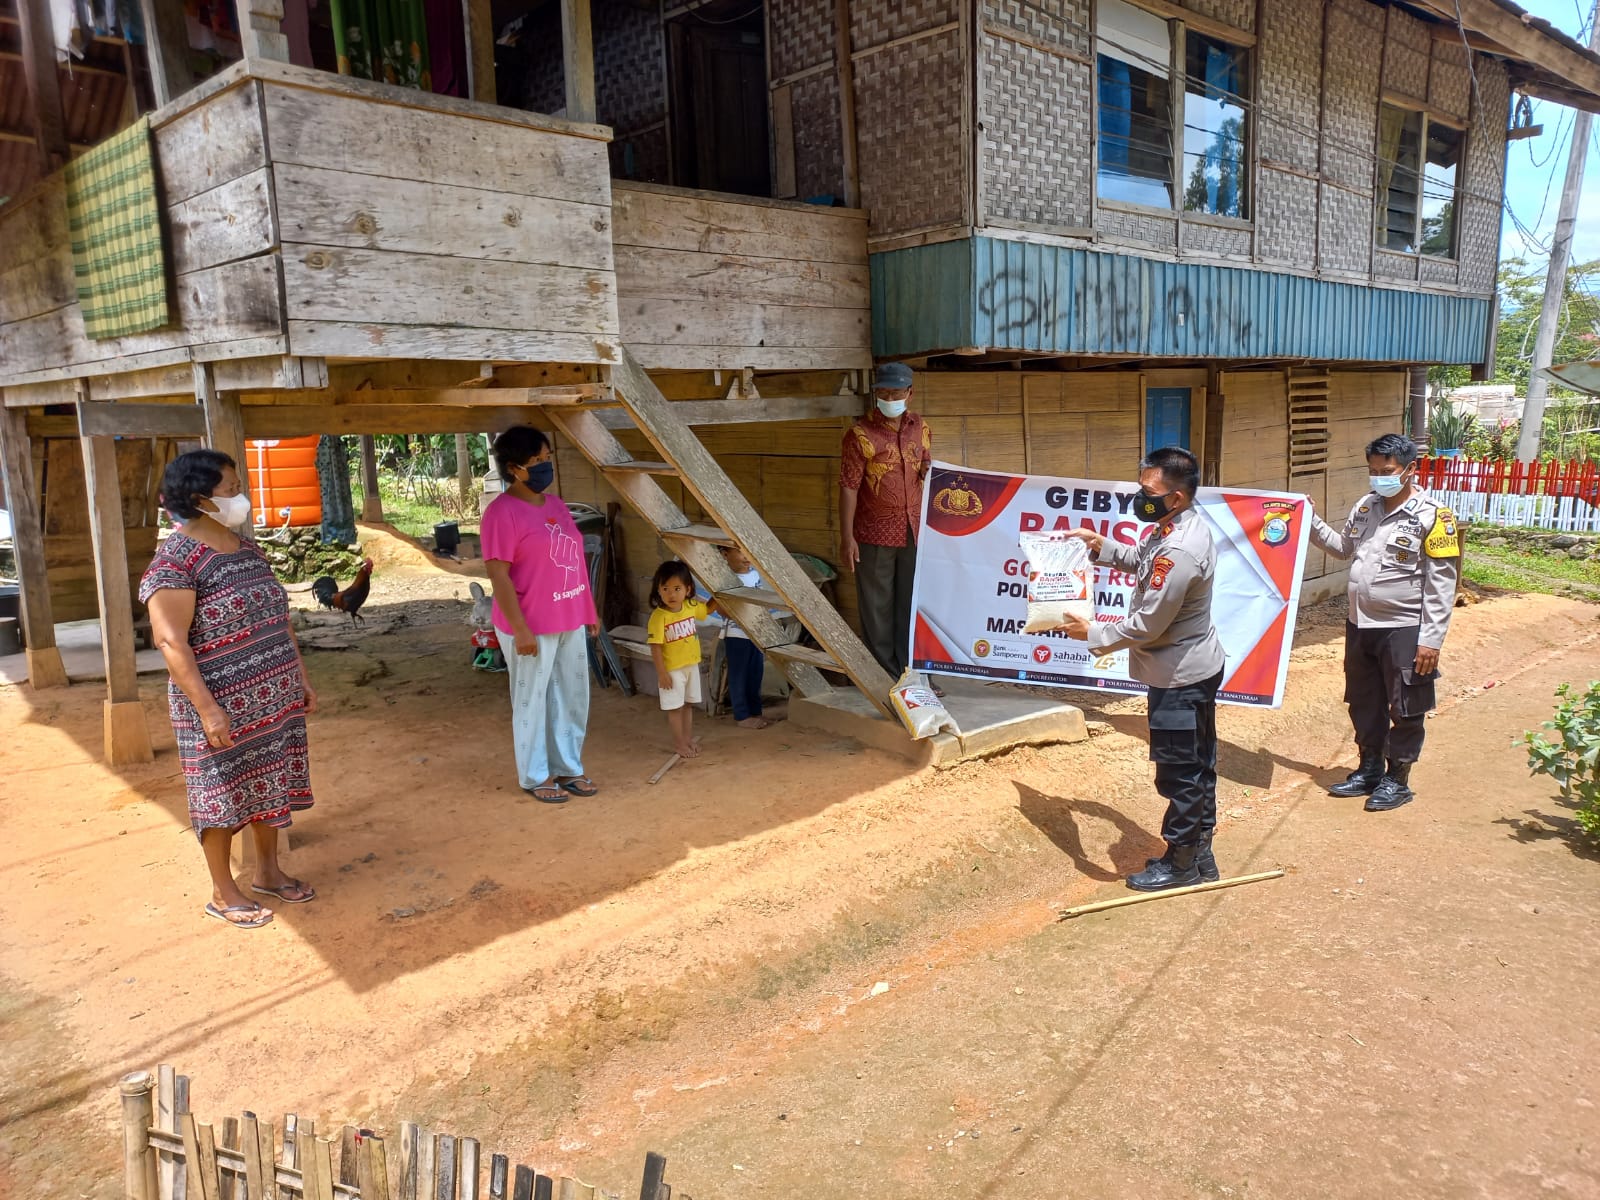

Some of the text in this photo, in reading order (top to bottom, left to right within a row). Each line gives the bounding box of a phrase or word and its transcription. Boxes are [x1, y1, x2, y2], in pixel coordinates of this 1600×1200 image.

[1045, 486, 1136, 515] GEBY
[1019, 512, 1156, 548] BANS
[665, 618, 696, 641] MARV
[992, 650, 1028, 660] Sampoerna
[1053, 651, 1091, 662] sahabat
